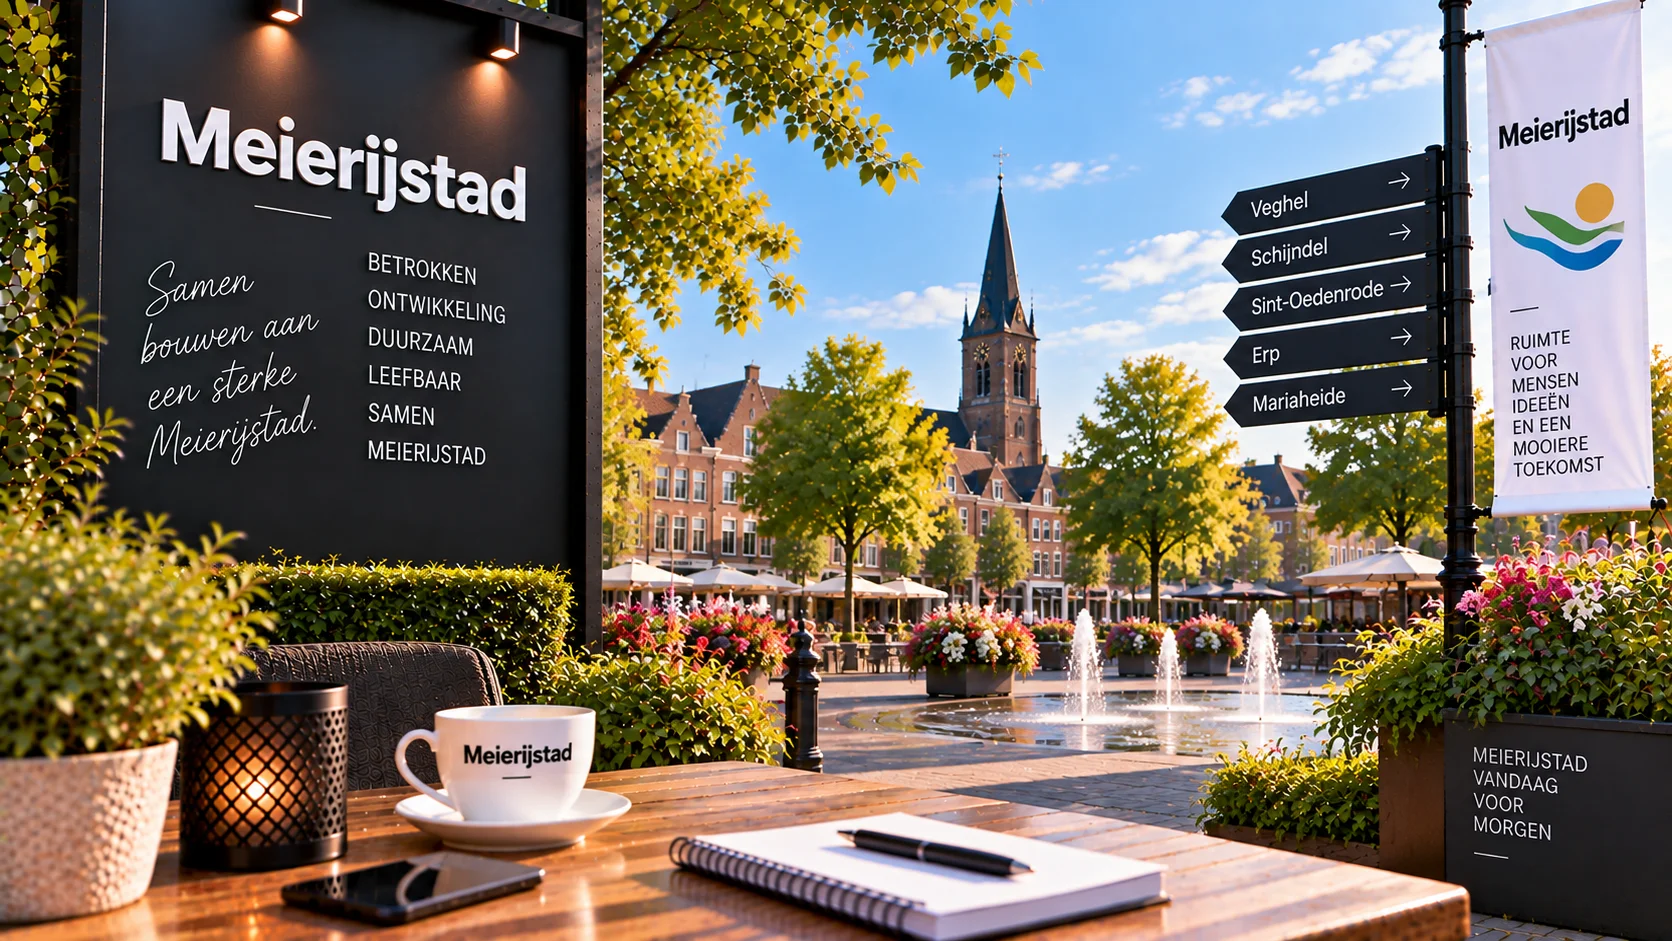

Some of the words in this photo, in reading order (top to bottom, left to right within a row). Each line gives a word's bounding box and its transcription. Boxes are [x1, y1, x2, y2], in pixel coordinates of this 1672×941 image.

[1499, 98, 1629, 149] Meierijstad
[162, 98, 526, 221] Meierijstad
[1251, 191, 1307, 218] Veghel
[1252, 237, 1327, 266] Schijndel
[369, 252, 476, 285] BETROKKEN
[146, 261, 254, 316] Samen
[1252, 280, 1383, 314] Sint-Oedenrode
[369, 290, 505, 324] ONTWIKKELING
[141, 323, 253, 364] bouwen
[264, 314, 319, 338] aan
[369, 327, 472, 356] DUURZAAM
[1511, 330, 1570, 350] RUIMTE
[1253, 347, 1279, 365] Erp
[1511, 353, 1557, 371] VOOR
[149, 385, 200, 410] een
[212, 352, 297, 403] sterke
[369, 365, 460, 391] LEEFBAAR
[1513, 372, 1578, 393] MENSEN
[1254, 387, 1345, 412] Mariaheide
[1513, 392, 1569, 413] IDEEËN
[369, 403, 434, 425] SAMEN
[1514, 419, 1533, 434] EN
[1540, 416, 1570, 432] EEN
[147, 395, 316, 469] Meierijstad.
[369, 440, 485, 465] MEIERIJSTAD
[1514, 436, 1588, 456] MOOIERE
[1514, 456, 1604, 477] TOEKOMST
[464, 743, 572, 768] Meierijstad
[1474, 747, 1587, 772] MEIERIJSTAD
[1474, 770, 1558, 793] VANDAAG
[1474, 793, 1523, 813] VOOR
[1474, 816, 1550, 840] MORGEN
